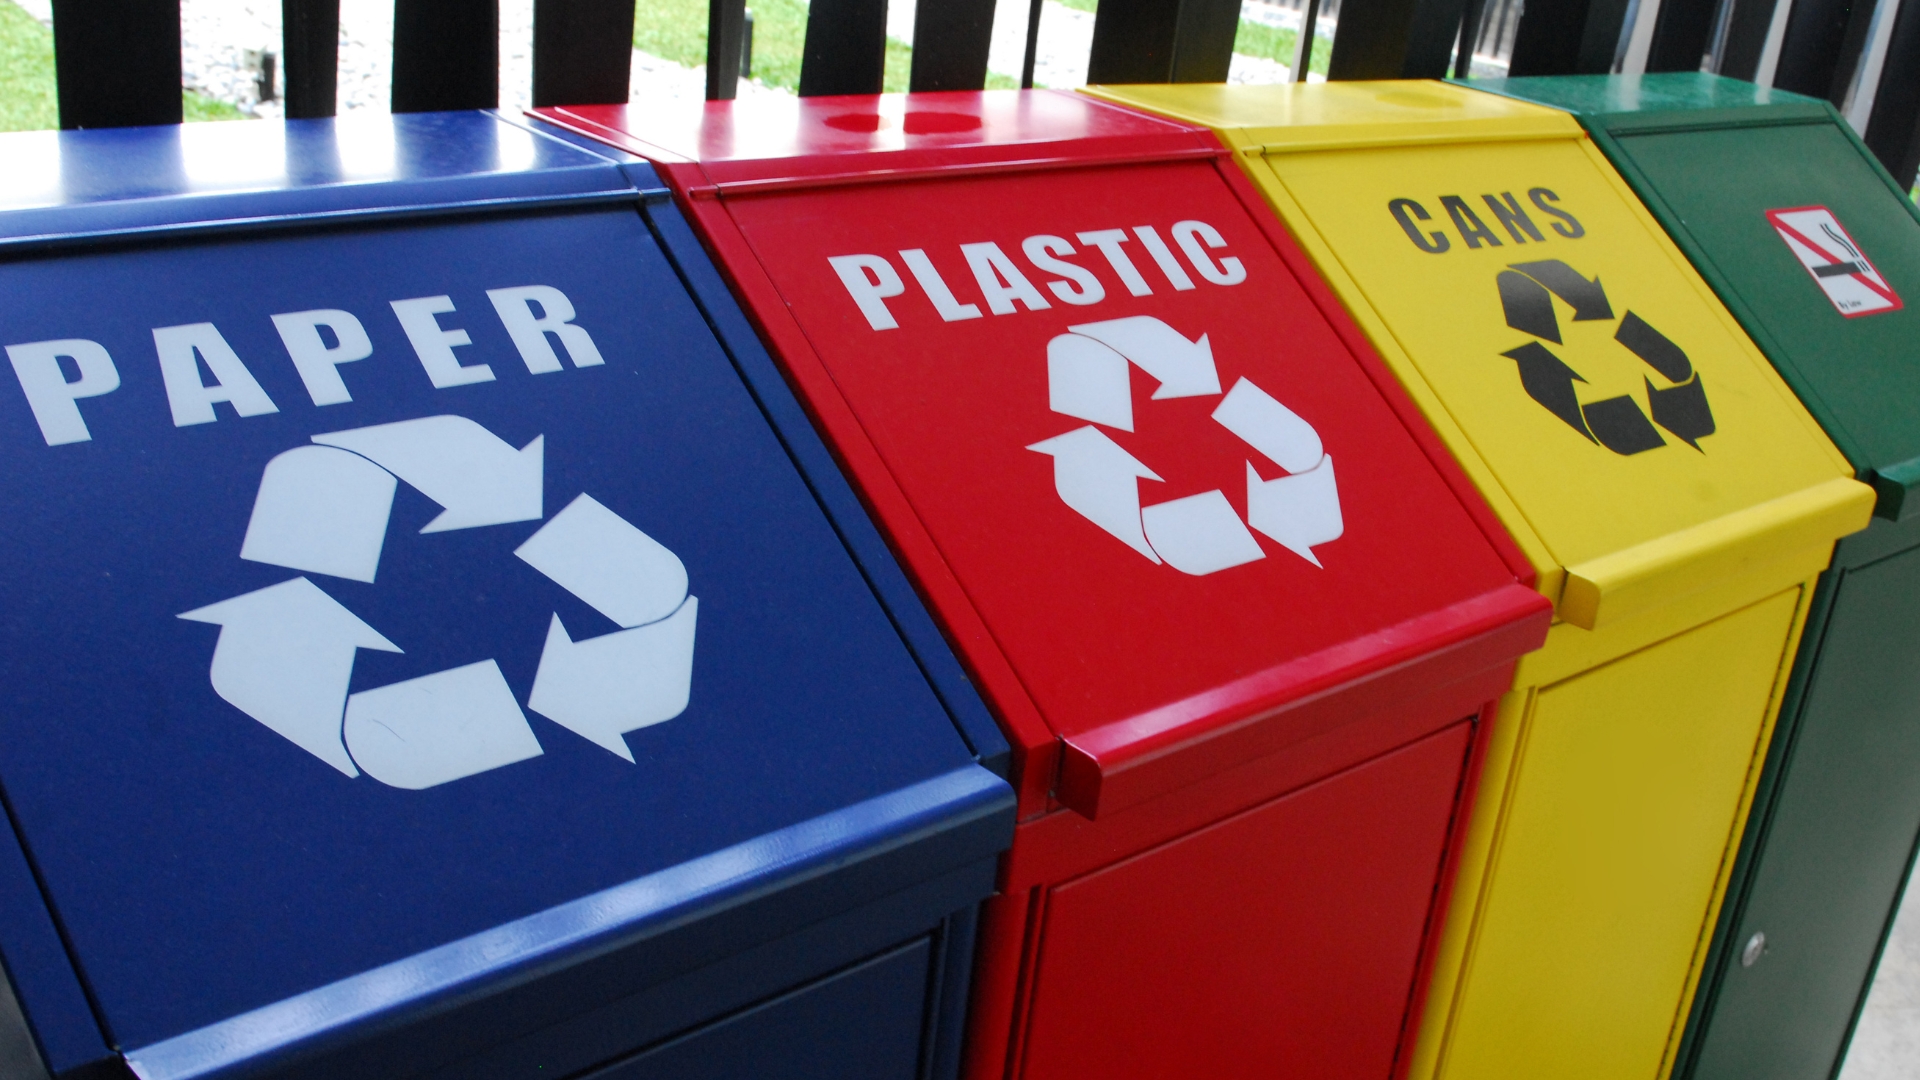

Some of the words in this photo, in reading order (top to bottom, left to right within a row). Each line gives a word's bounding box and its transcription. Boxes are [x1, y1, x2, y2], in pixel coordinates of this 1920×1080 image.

[827, 219, 1247, 331] PLASTIC
[1388, 187, 1585, 254] CANS
[4, 284, 605, 446] PAPER
